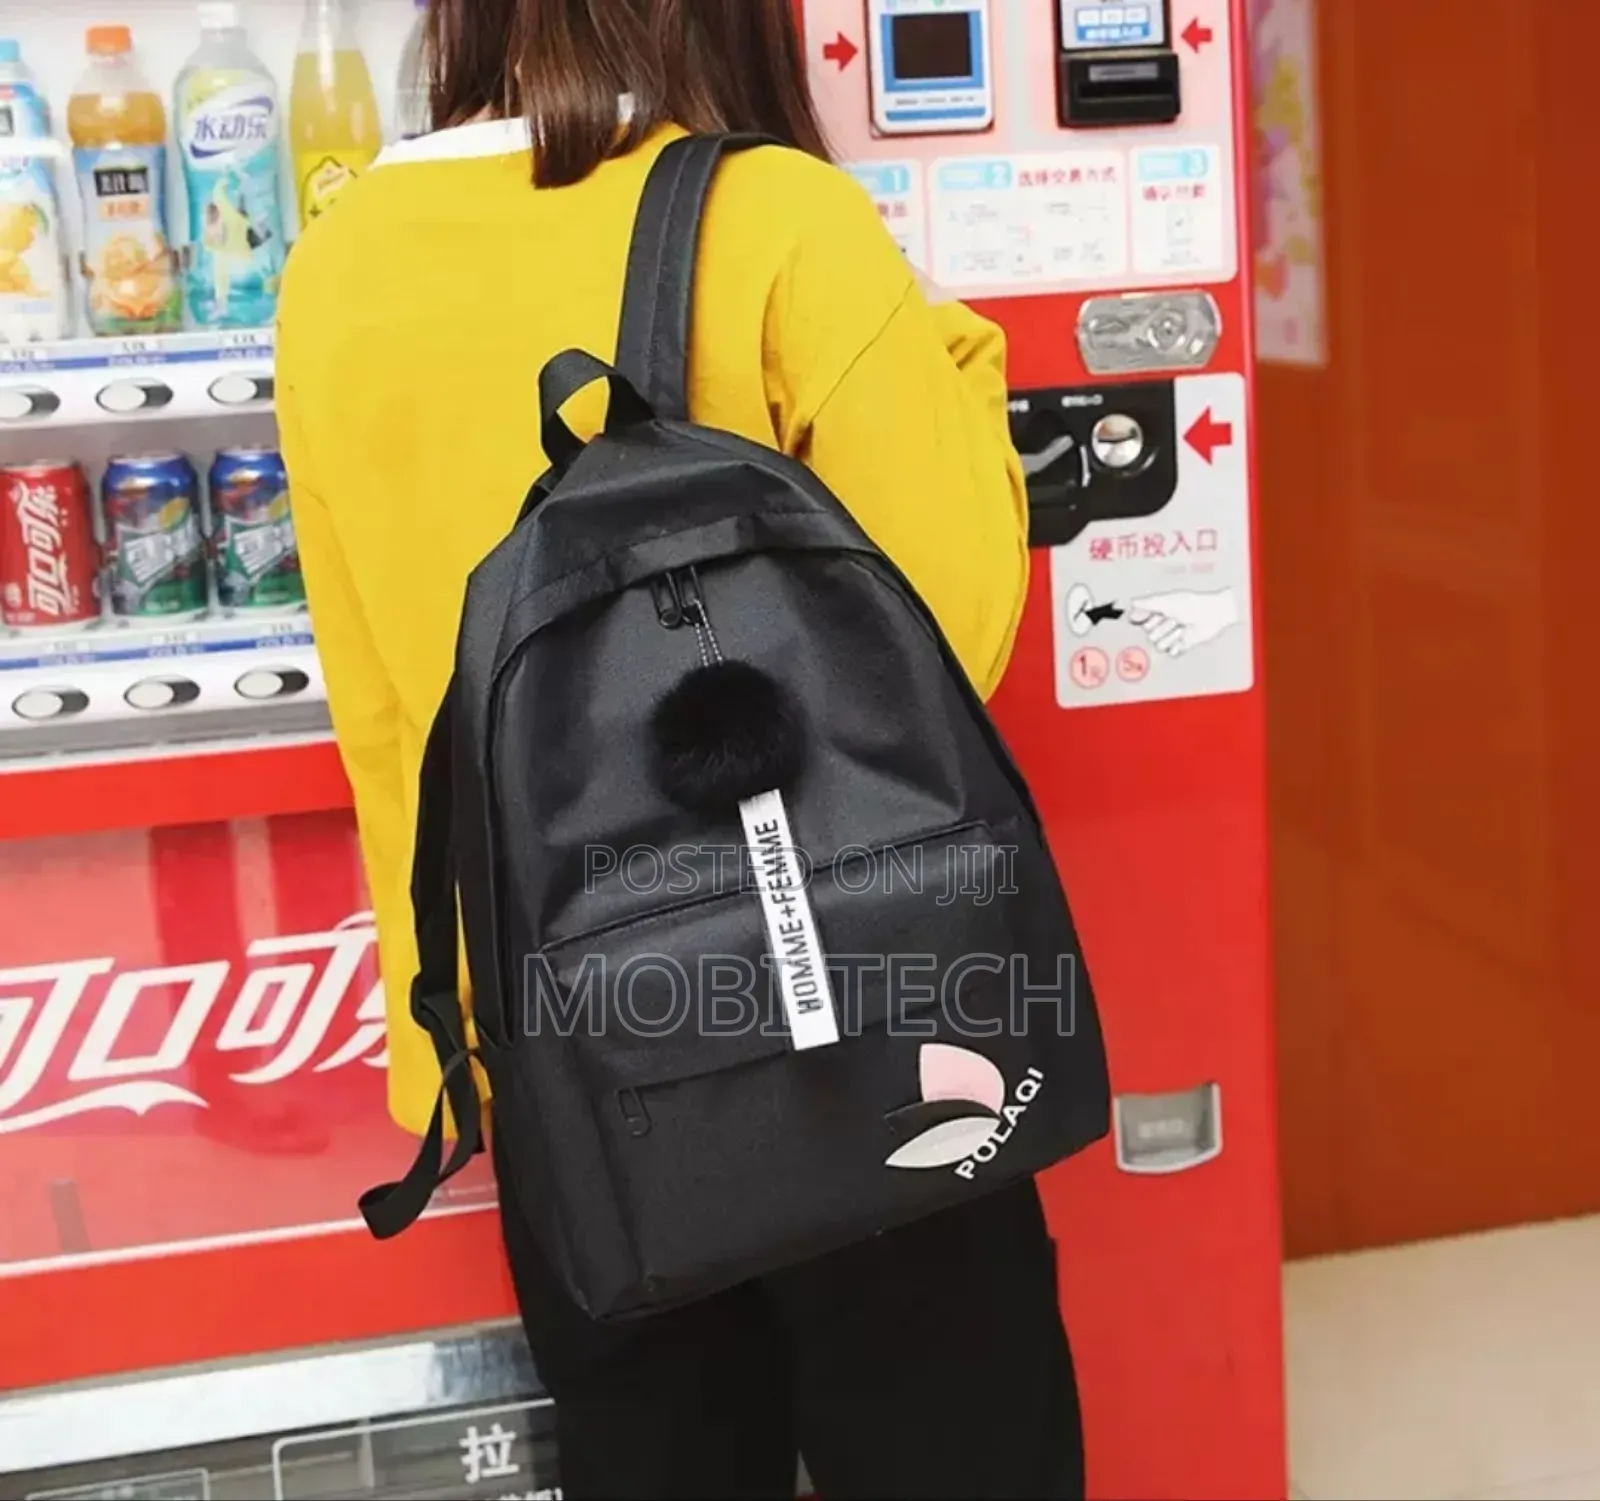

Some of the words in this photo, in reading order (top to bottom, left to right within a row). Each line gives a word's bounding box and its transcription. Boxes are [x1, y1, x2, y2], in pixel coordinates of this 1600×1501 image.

[1088, 528, 1219, 562] 硬币投入口
[754, 818, 824, 1015] HOMME+FEMME
[954, 1066, 1044, 1180] POLAQI
[459, 1422, 519, 1484] 拉
